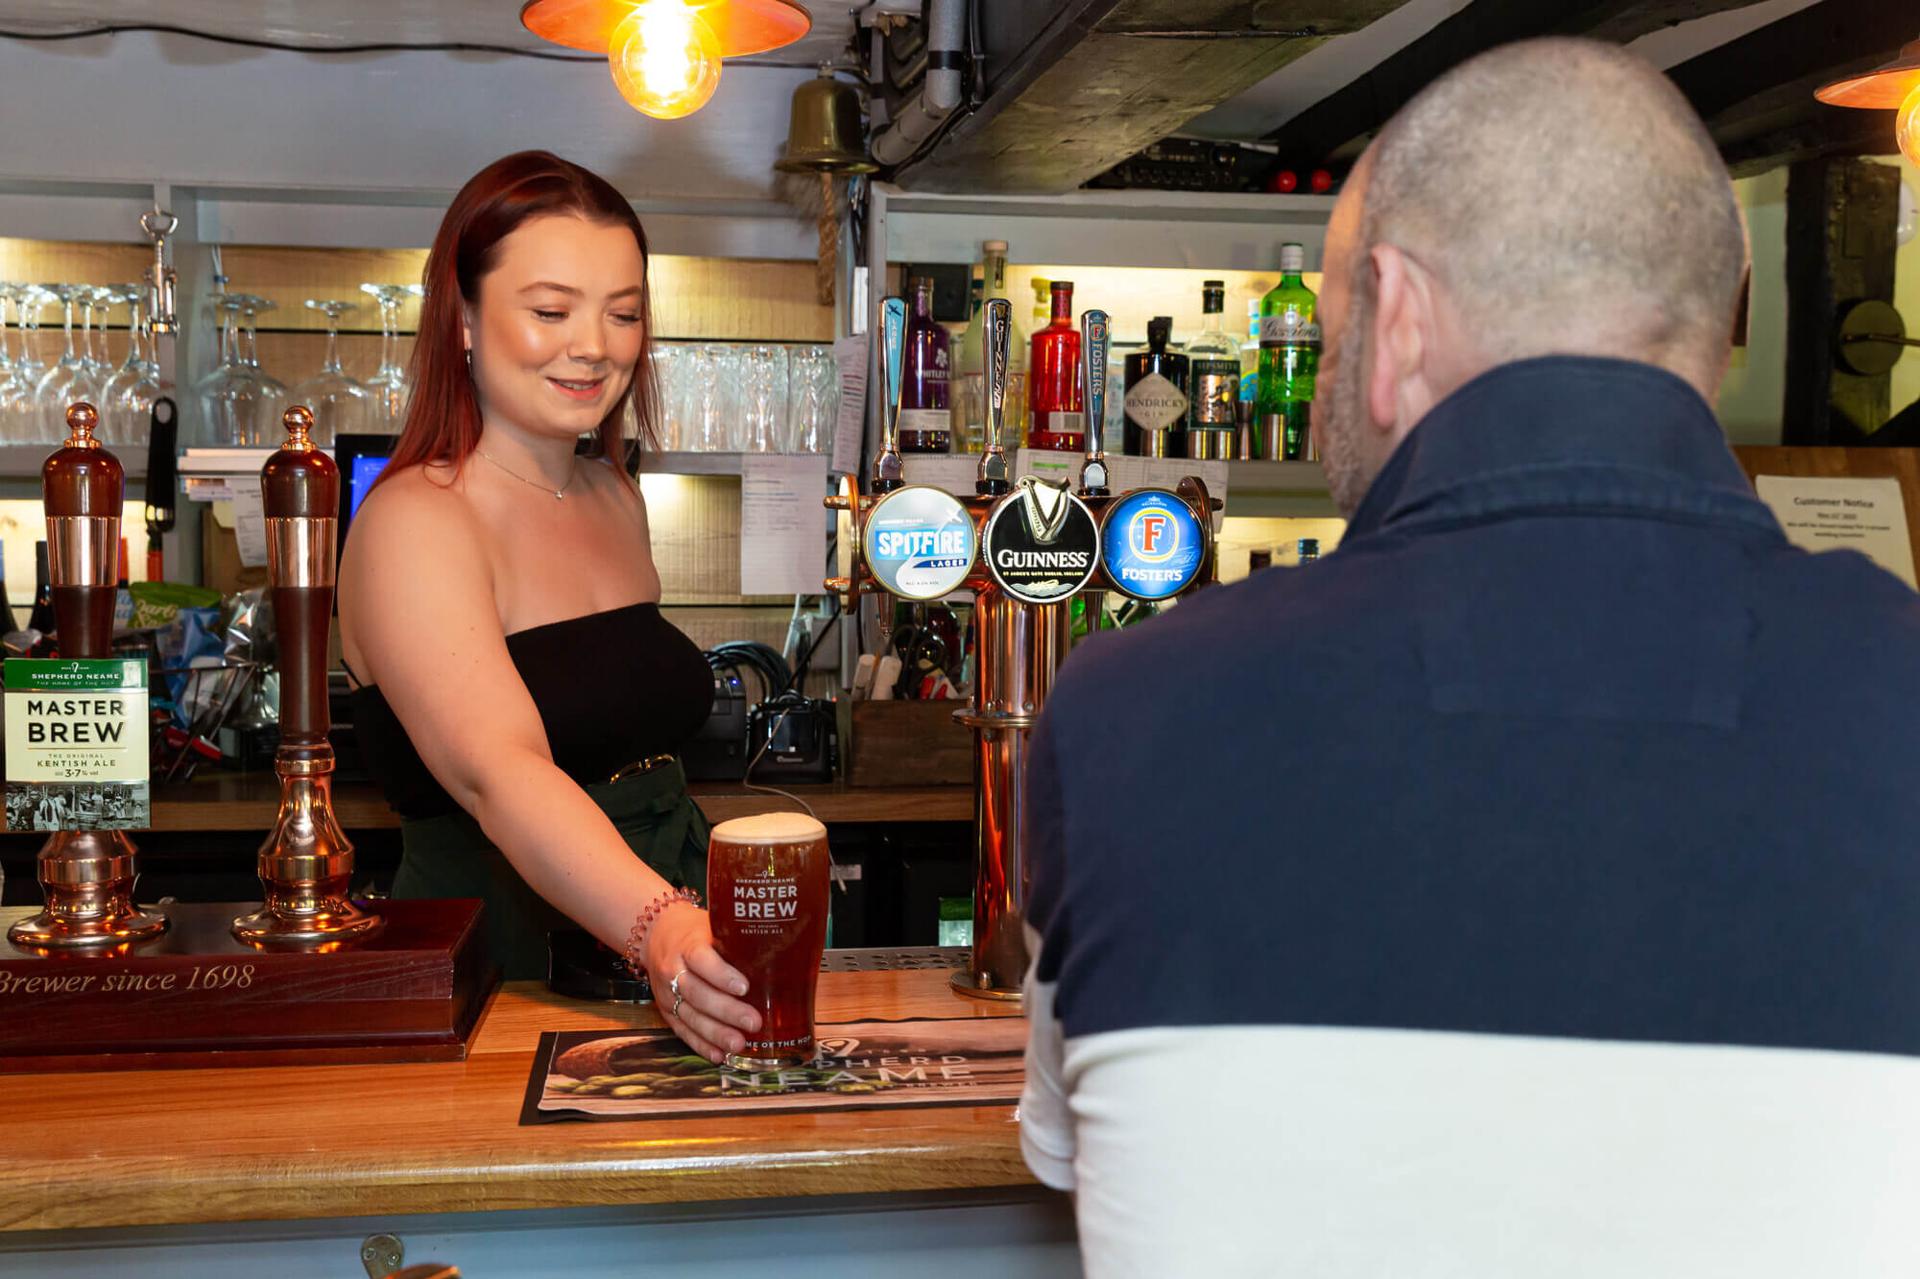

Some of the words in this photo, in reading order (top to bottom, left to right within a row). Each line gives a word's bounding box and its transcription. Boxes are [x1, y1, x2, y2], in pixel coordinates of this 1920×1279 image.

[1793, 496, 1842, 508] Customer
[1843, 499, 1875, 509] Notice
[1142, 516, 1168, 553] F
[878, 530, 966, 557] SPITFIRE
[929, 559, 965, 568] LAGER
[997, 548, 1089, 569] GUINNESS
[31, 672, 84, 680] SHEPHERD
[86, 671, 121, 680] NEAME
[27, 700, 125, 716] MASTER
[28, 721, 125, 743] BREW
[37, 759, 88, 768] KENTISH
[93, 759, 117, 767] ALE
[733, 885, 798, 900] MASTER
[734, 900, 798, 918] BREW
[0, 970, 97, 994] Brewer
[102, 968, 178, 992] since
[186, 964, 256, 991] 1698
[777, 1039, 796, 1048] THE
[815, 1055, 968, 1070] PHERD
[720, 1064, 975, 1089] NEAME
